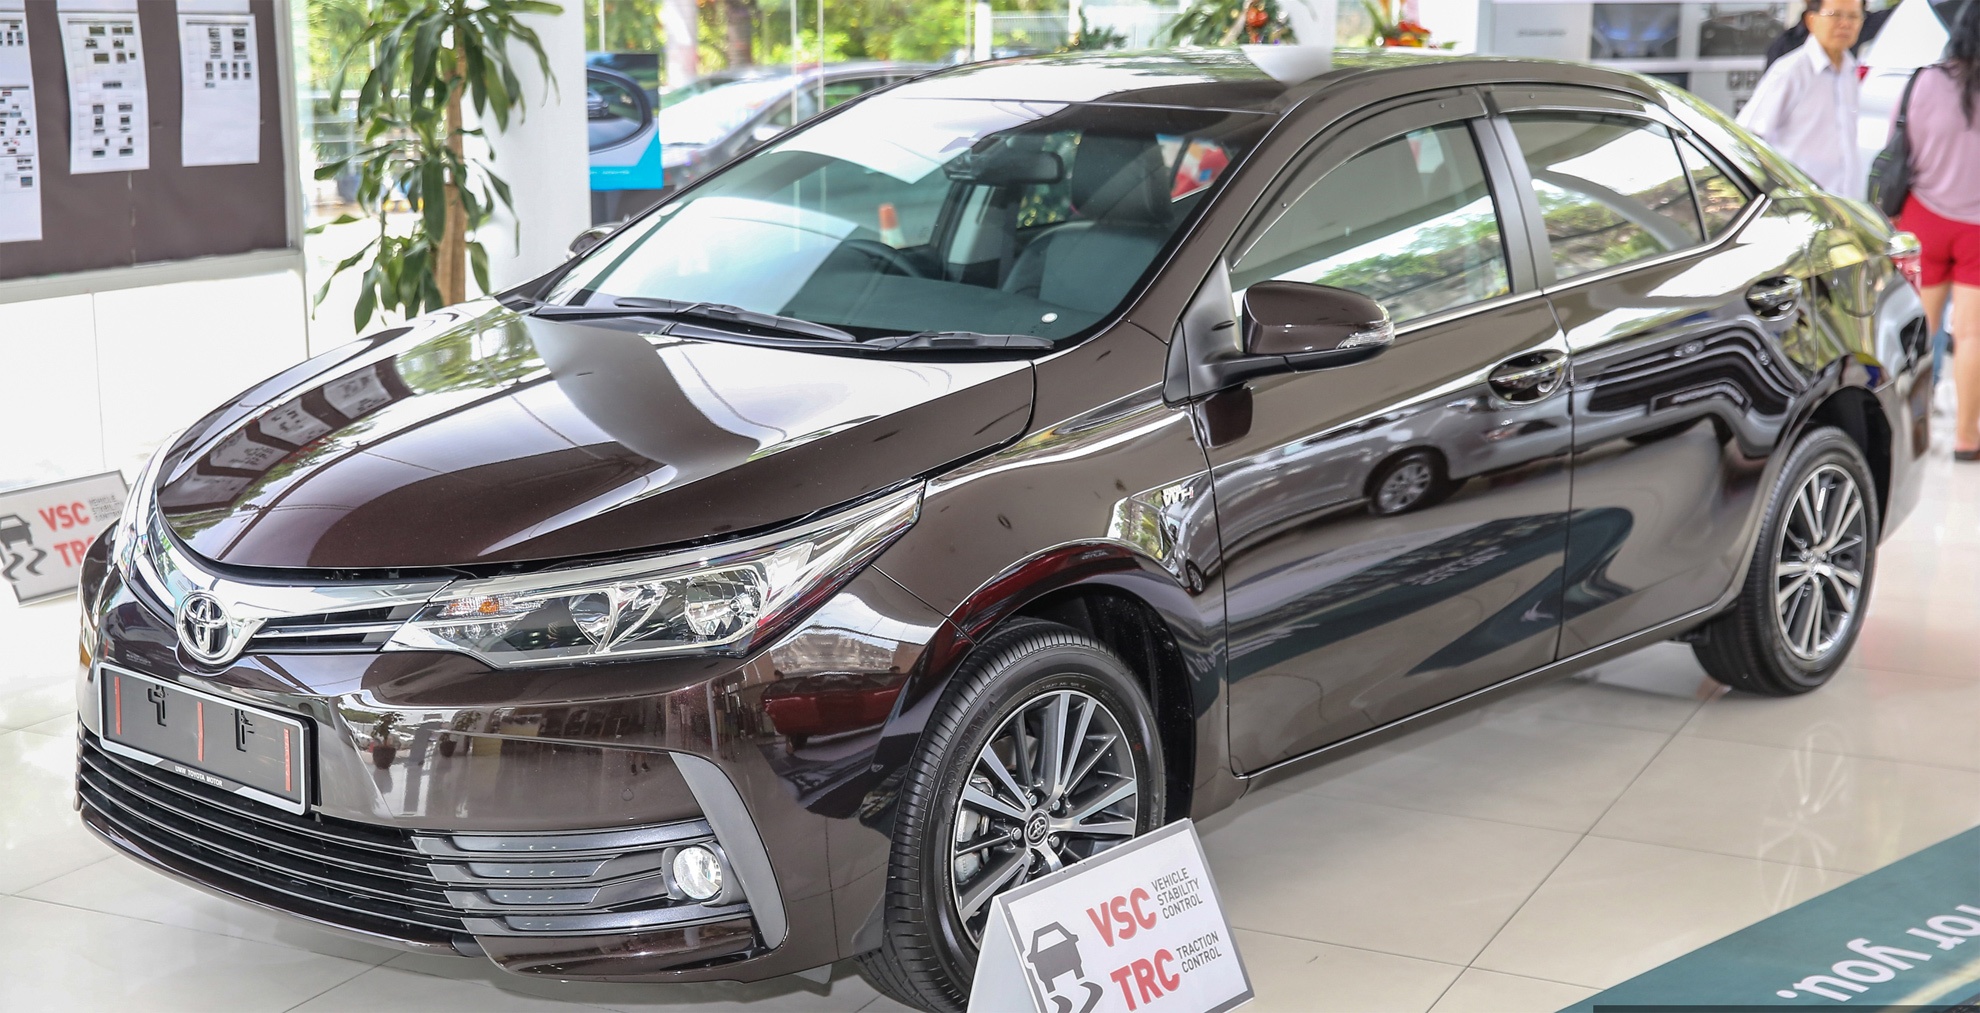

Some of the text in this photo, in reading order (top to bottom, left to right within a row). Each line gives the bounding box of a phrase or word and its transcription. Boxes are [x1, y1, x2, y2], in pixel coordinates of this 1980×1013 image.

[37, 501, 91, 532] VSC
[187, 769, 206, 782] TOYOTA
[206, 775, 223, 788] MOTOR
[1151, 867, 1190, 893] VEHICLE
[1156, 877, 1200, 906] STABILITY
[1085, 887, 1157, 948] VSC
[1162, 893, 1203, 920] CONTROL
[1175, 930, 1220, 960] TRACTION
[1180, 945, 1223, 974] CONTROL
[1109, 948, 1181, 1012] TRC
[1776, 937, 1933, 1003] you.
